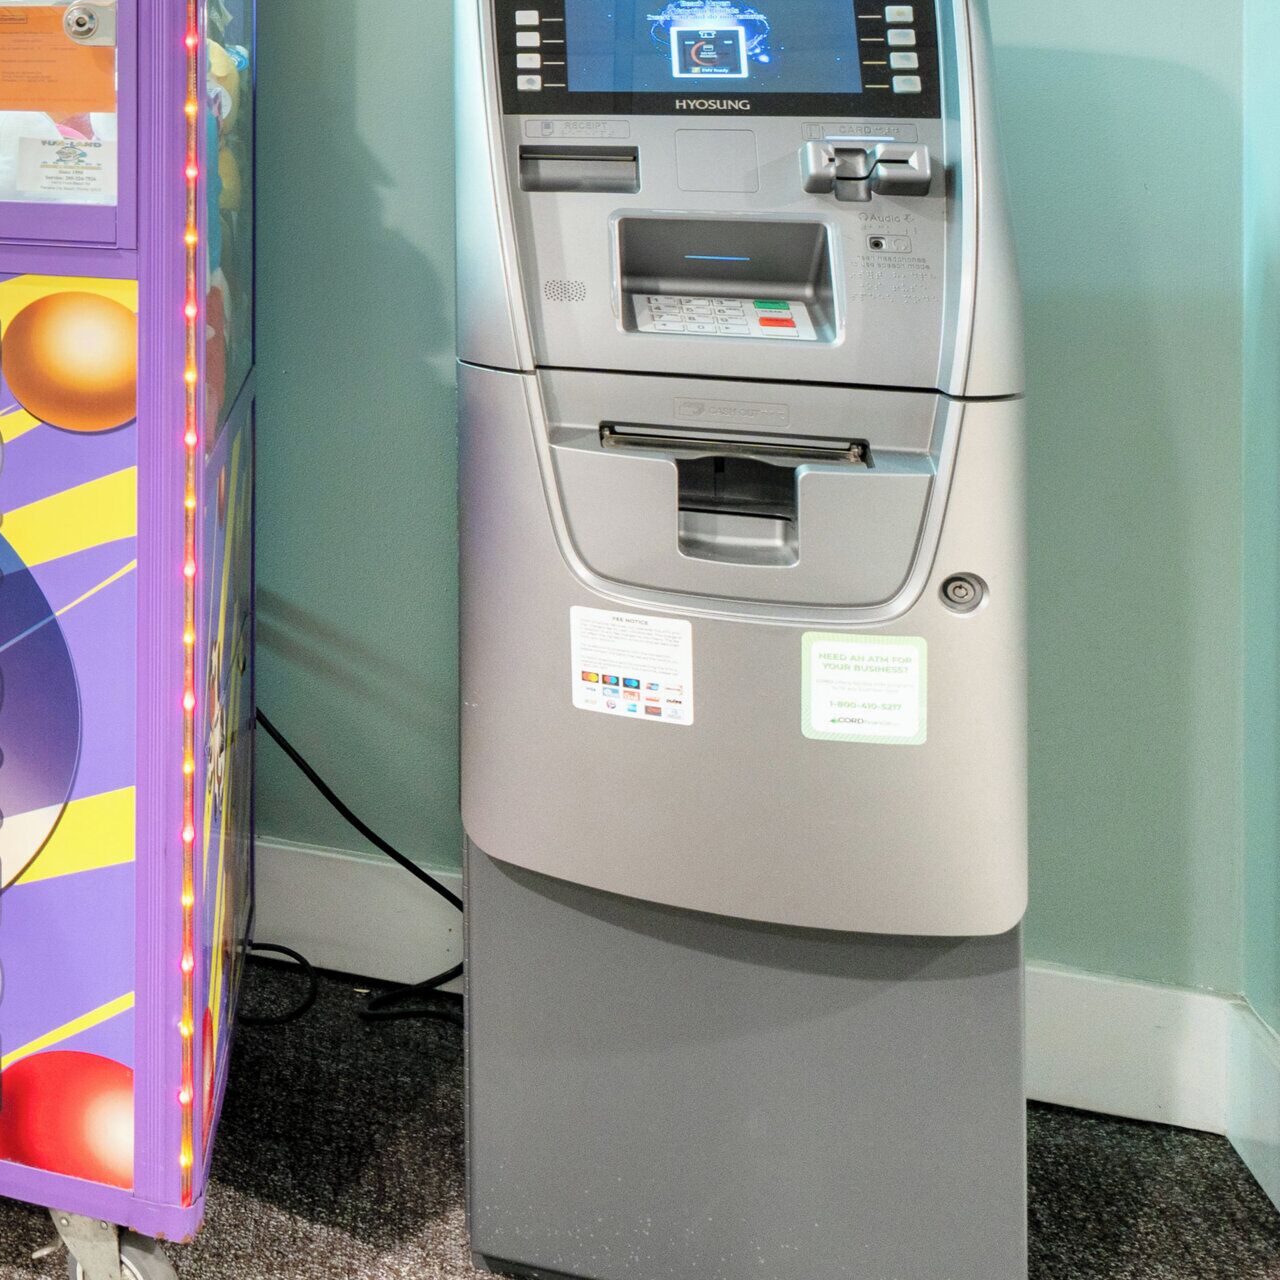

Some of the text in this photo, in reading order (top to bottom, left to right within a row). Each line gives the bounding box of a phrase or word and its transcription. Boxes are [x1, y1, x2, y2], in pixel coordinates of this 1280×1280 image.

[675, 99, 751, 111] HYOSUNG
[564, 121, 608, 130] RECEIPT
[839, 125, 872, 134] CARD
[869, 214, 901, 223] Audio
[818, 653, 847, 661] NEED
[850, 654, 865, 662] AN
[868, 655, 889, 663] ATM
[823, 663, 908, 674] YOUR BUSINESS?
